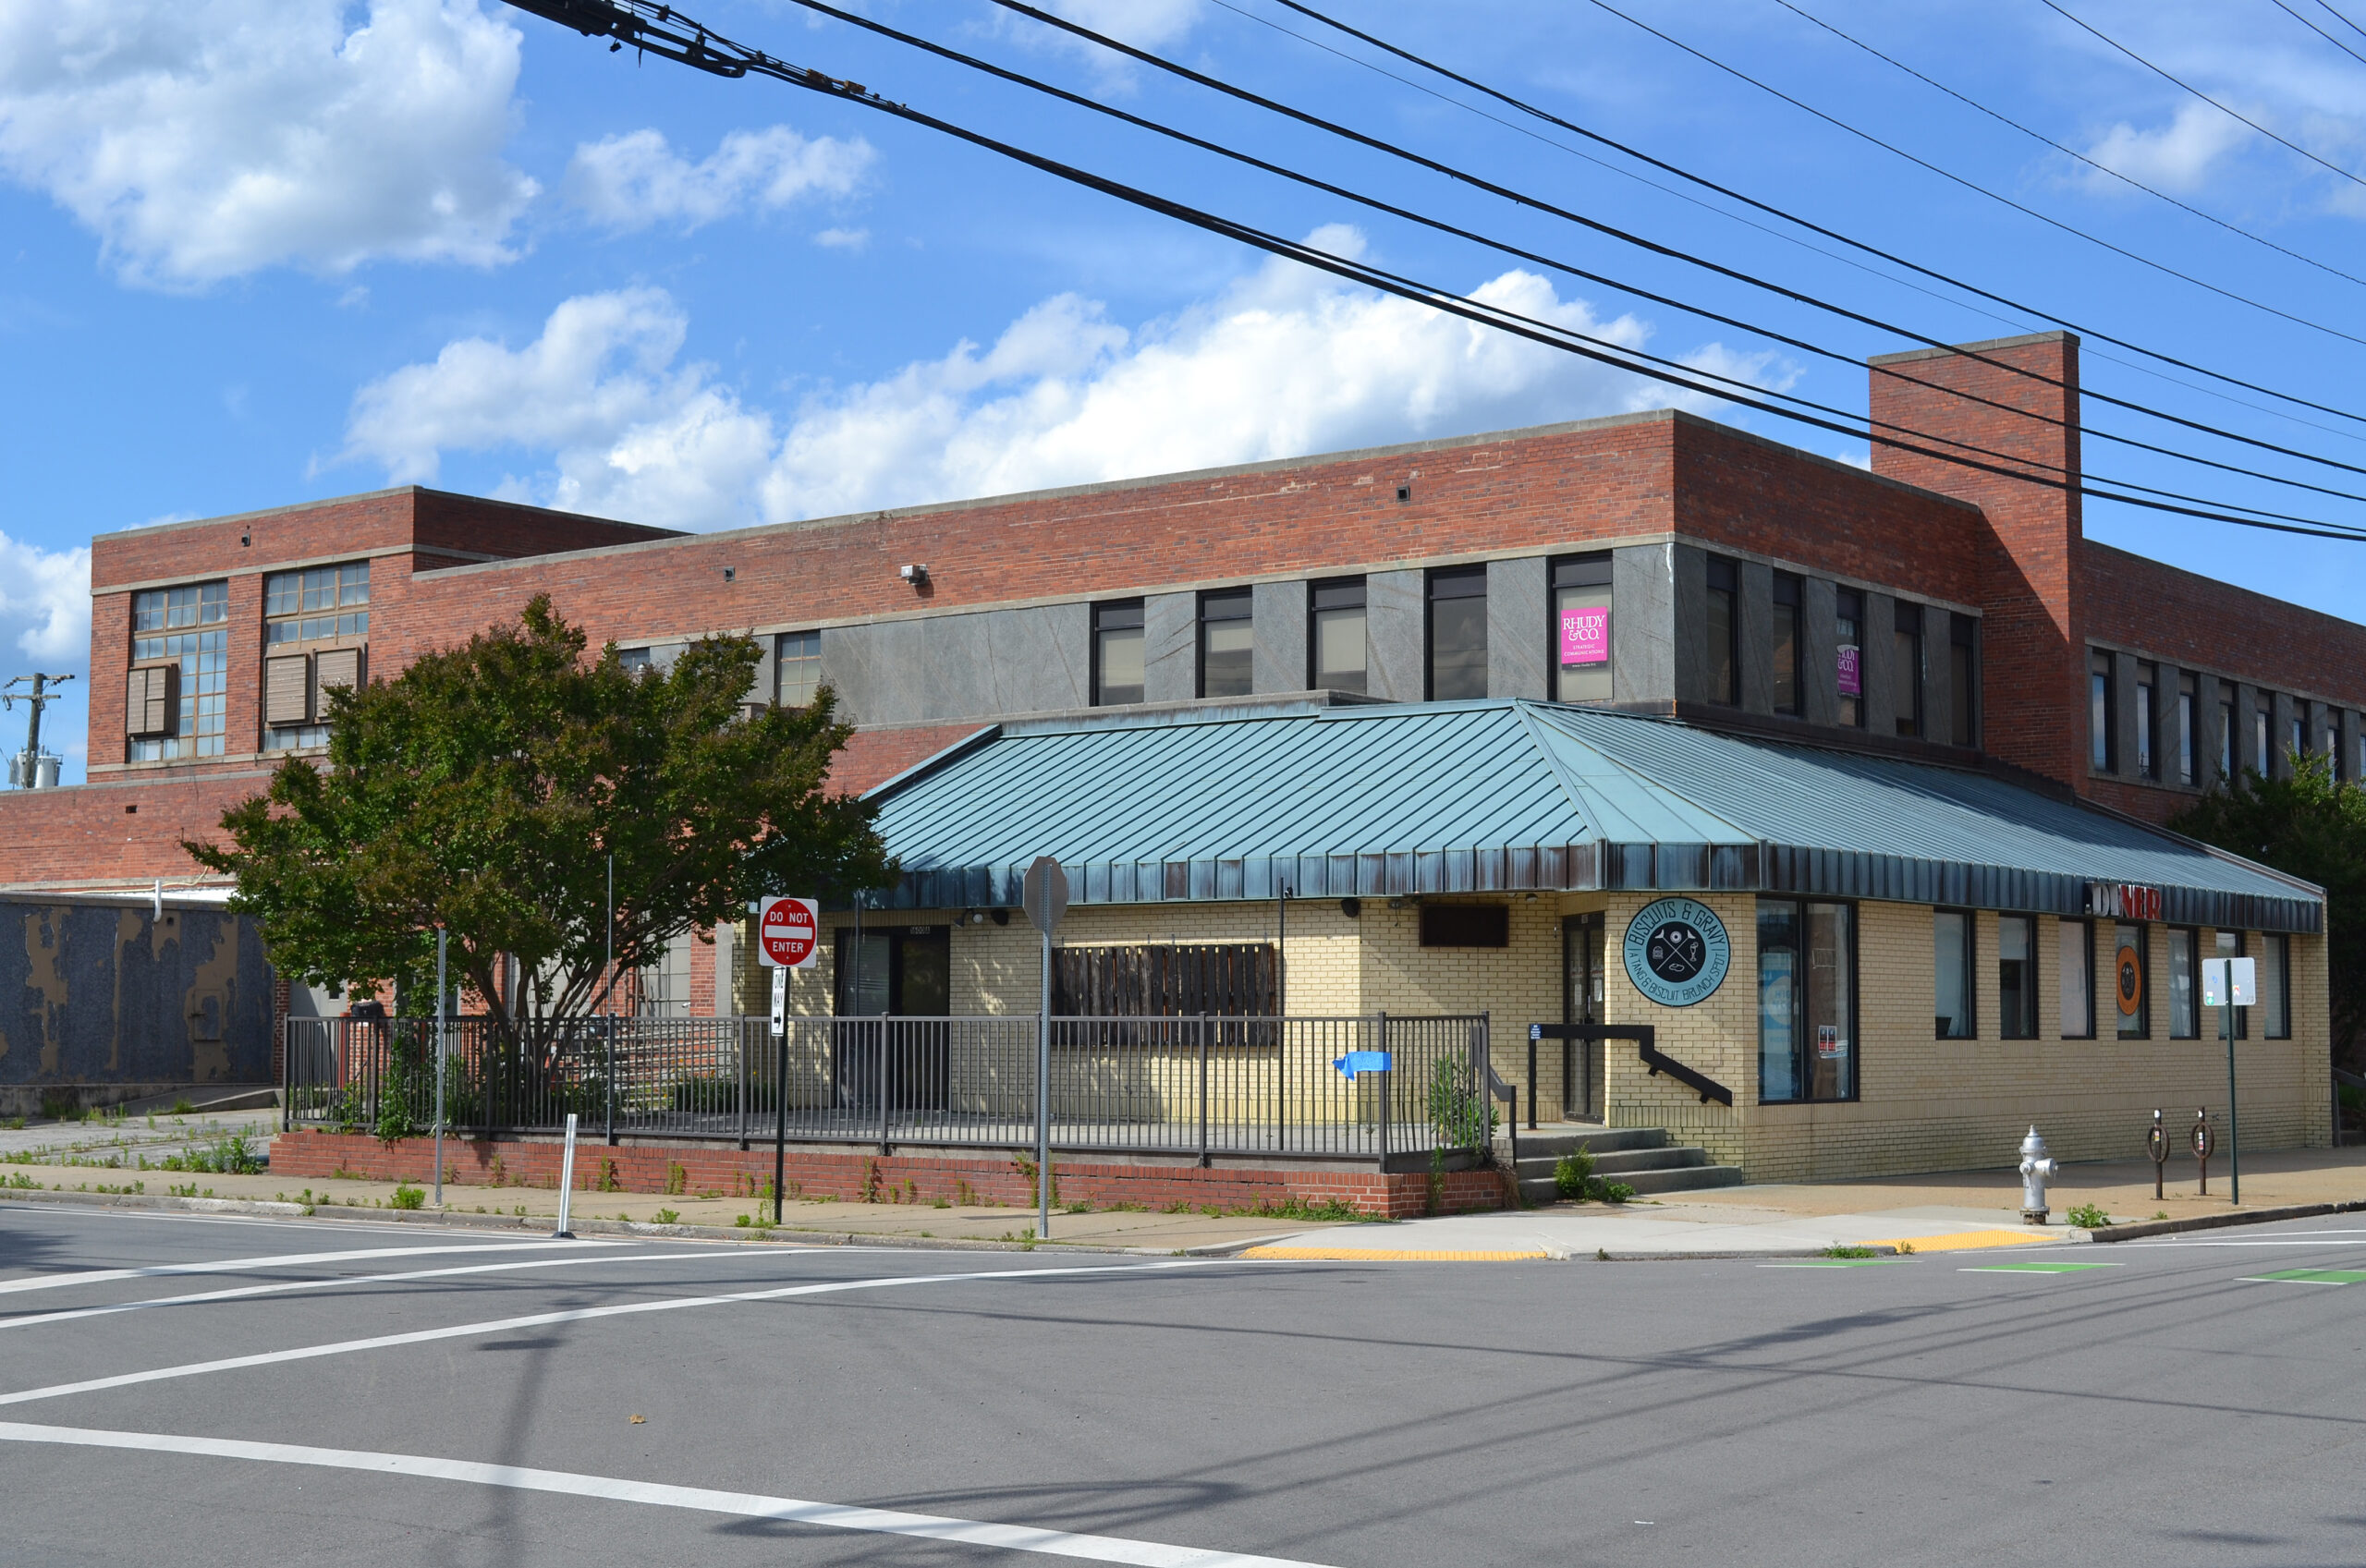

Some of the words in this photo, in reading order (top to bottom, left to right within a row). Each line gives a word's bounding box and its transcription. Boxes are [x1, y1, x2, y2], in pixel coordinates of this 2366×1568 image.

[1563, 615, 1604, 630] RHUDY
[2092, 881, 2162, 922] DINER
[770, 911, 784, 922] DO
[788, 912, 809, 924] NOT
[1628, 901, 1676, 946] BISCUITS
[1682, 903, 1692, 920] &
[1693, 909, 1726, 945] GRAVY
[773, 942, 803, 954] ENTER
[774, 973, 784, 989] ONE
[1631, 958, 1647, 980] TANG
[1641, 977, 1652, 988] &
[1648, 983, 1679, 1001] BISCUIT
[1682, 975, 1715, 1001] BRUNCH
[1711, 953, 1726, 977] SPOT
[774, 992, 783, 1008] WAY
